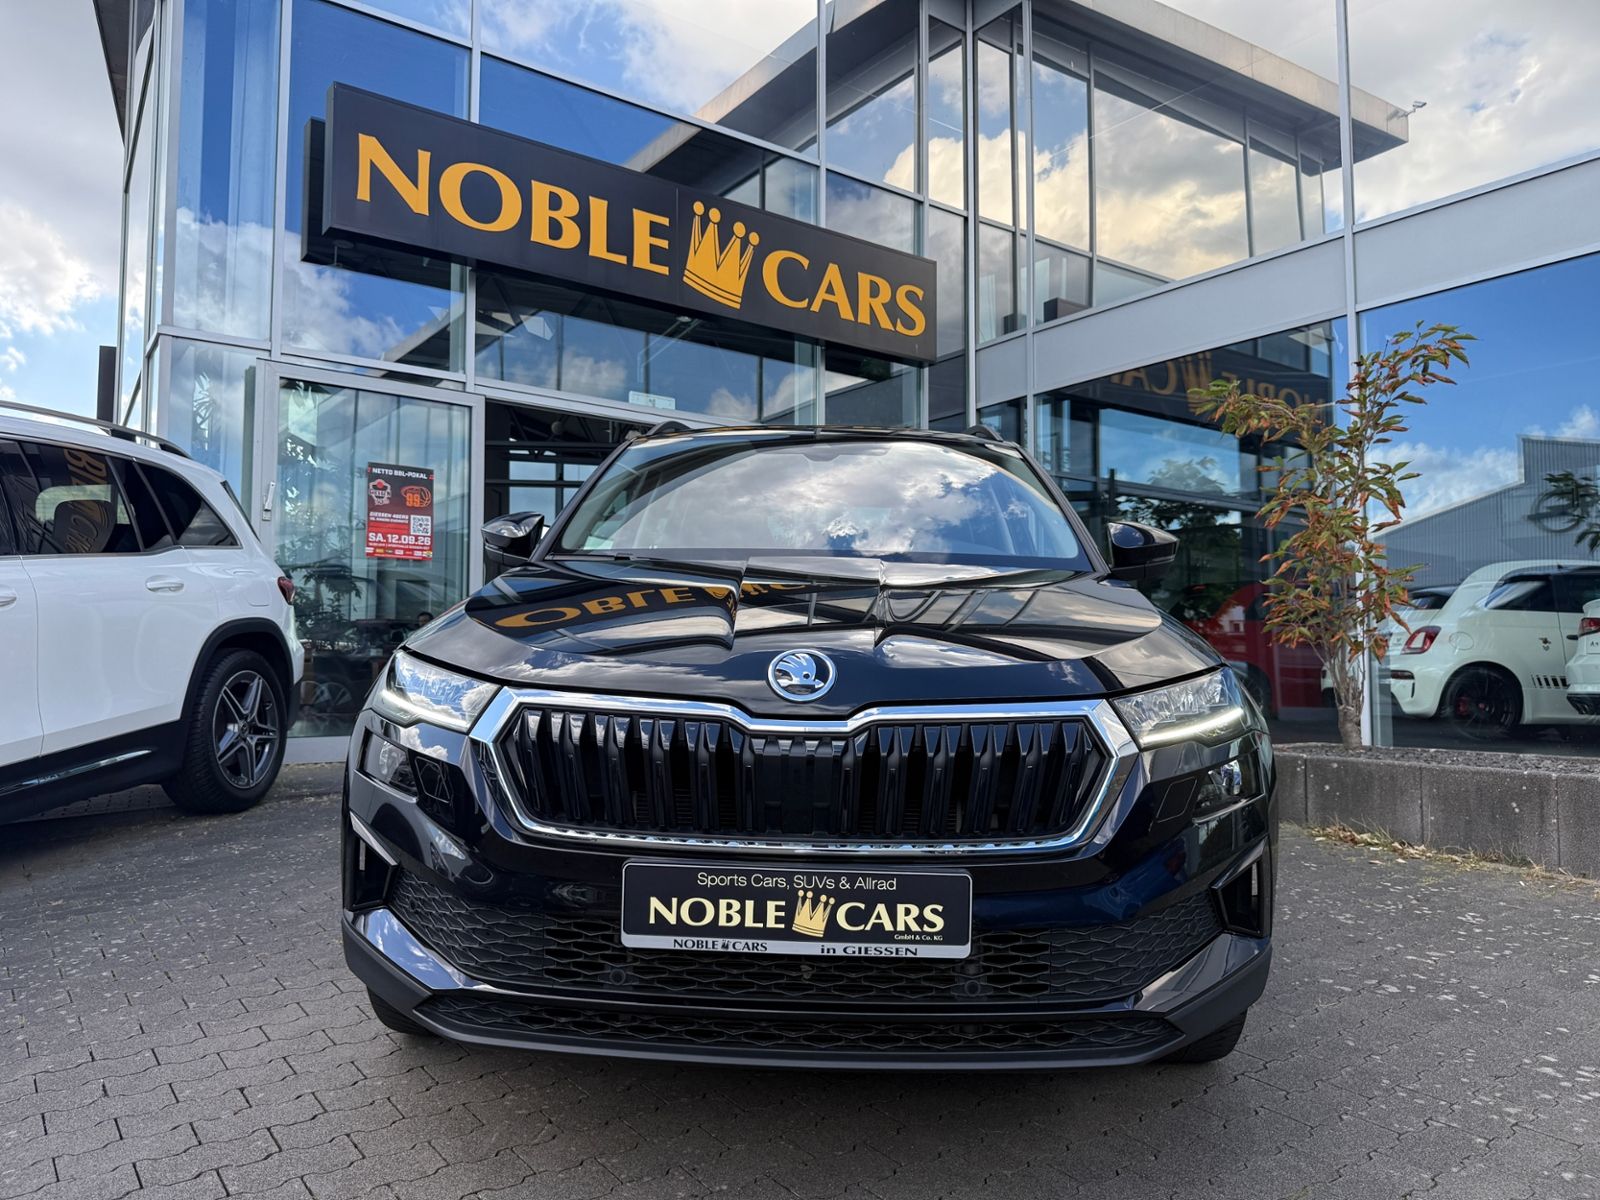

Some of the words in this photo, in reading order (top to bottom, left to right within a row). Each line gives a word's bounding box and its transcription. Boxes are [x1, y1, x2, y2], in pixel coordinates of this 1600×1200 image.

[356, 132, 670, 276] NOBLE
[762, 249, 927, 338] CARS
[372, 467, 393, 476] NETTO
[394, 470, 428, 480] BBL-POKAL
[406, 493, 420, 508] 99
[697, 872, 747, 888] Sports
[750, 873, 790, 890] Cars,
[793, 874, 835, 889] SUVs
[839, 876, 851, 889] &
[853, 876, 897, 891] Allrad
[648, 896, 786, 929] NOBLE
[836, 901, 945, 933] CARS
[673, 938, 719, 950] NOBLE
[732, 940, 768, 952] CARS
[820, 944, 836, 955] in
[843, 945, 918, 956] GIESSEN
